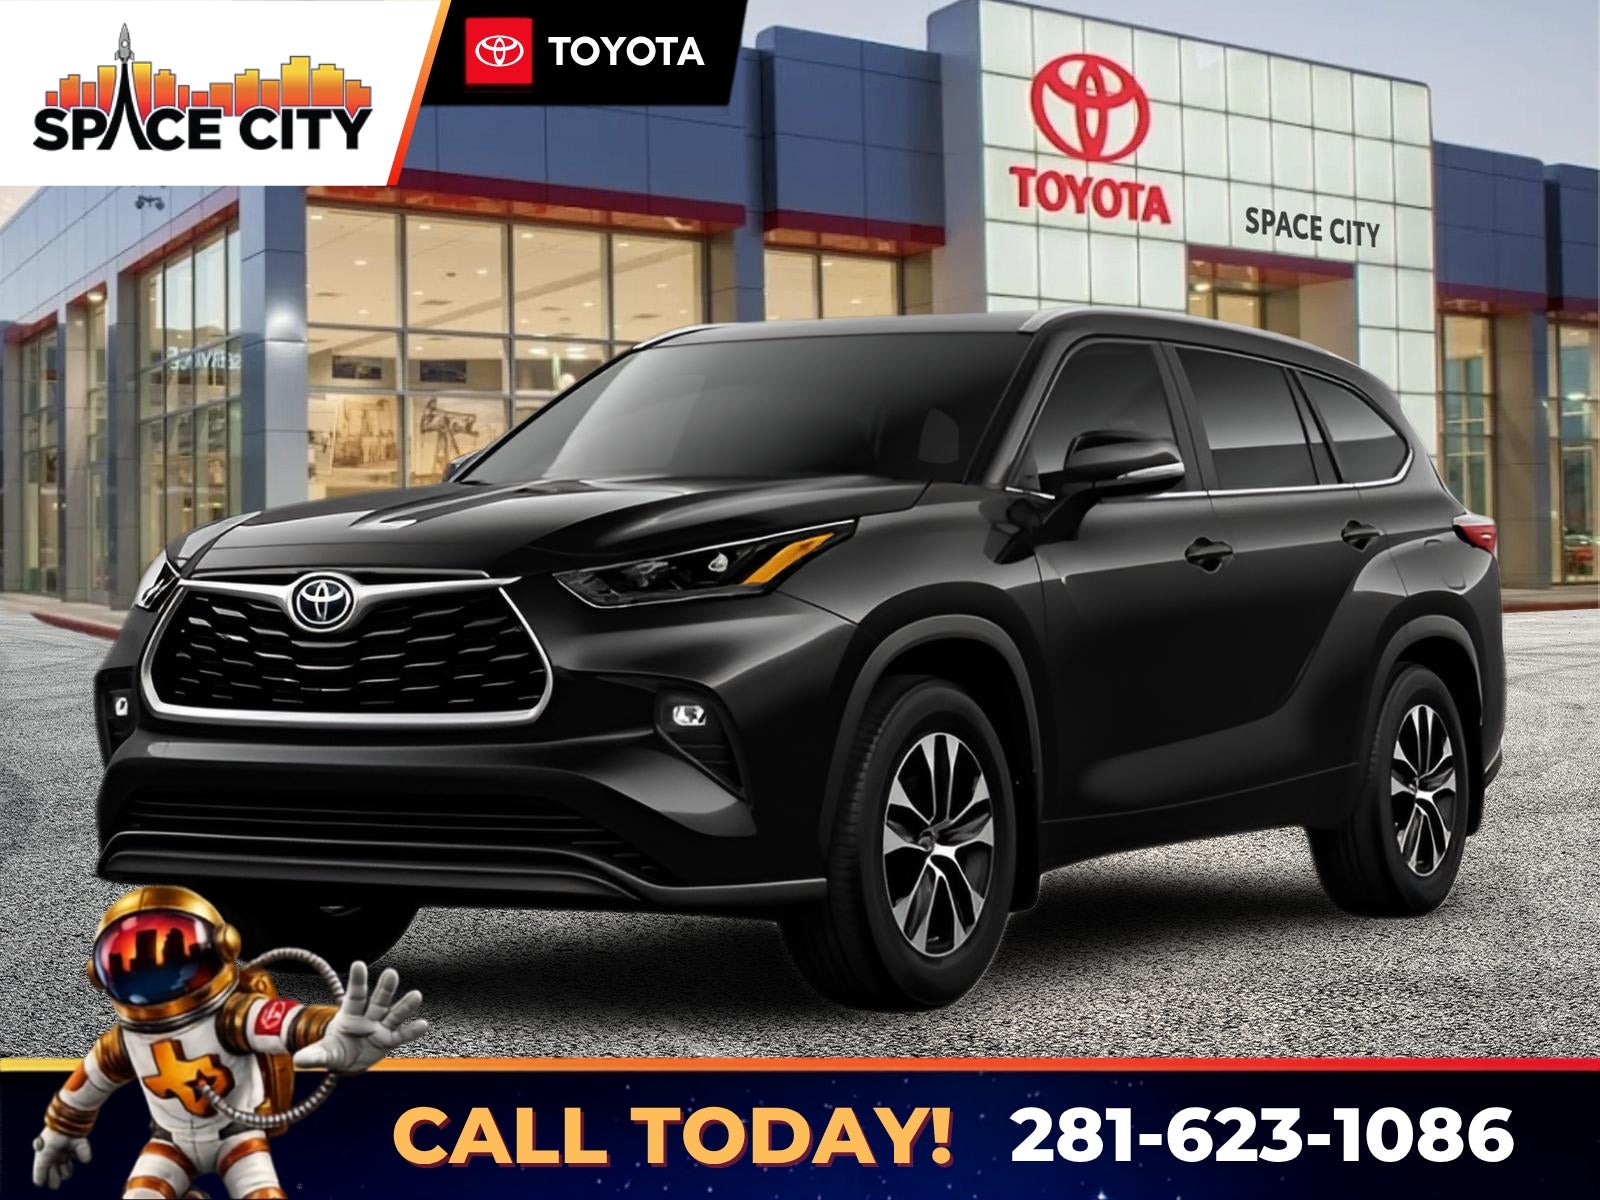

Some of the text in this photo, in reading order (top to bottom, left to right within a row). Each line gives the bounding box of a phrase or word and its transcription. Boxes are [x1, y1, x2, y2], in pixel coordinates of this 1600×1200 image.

[1009, 166, 1171, 224] TOYOTA
[1245, 207, 1381, 248] SPACE CITY
